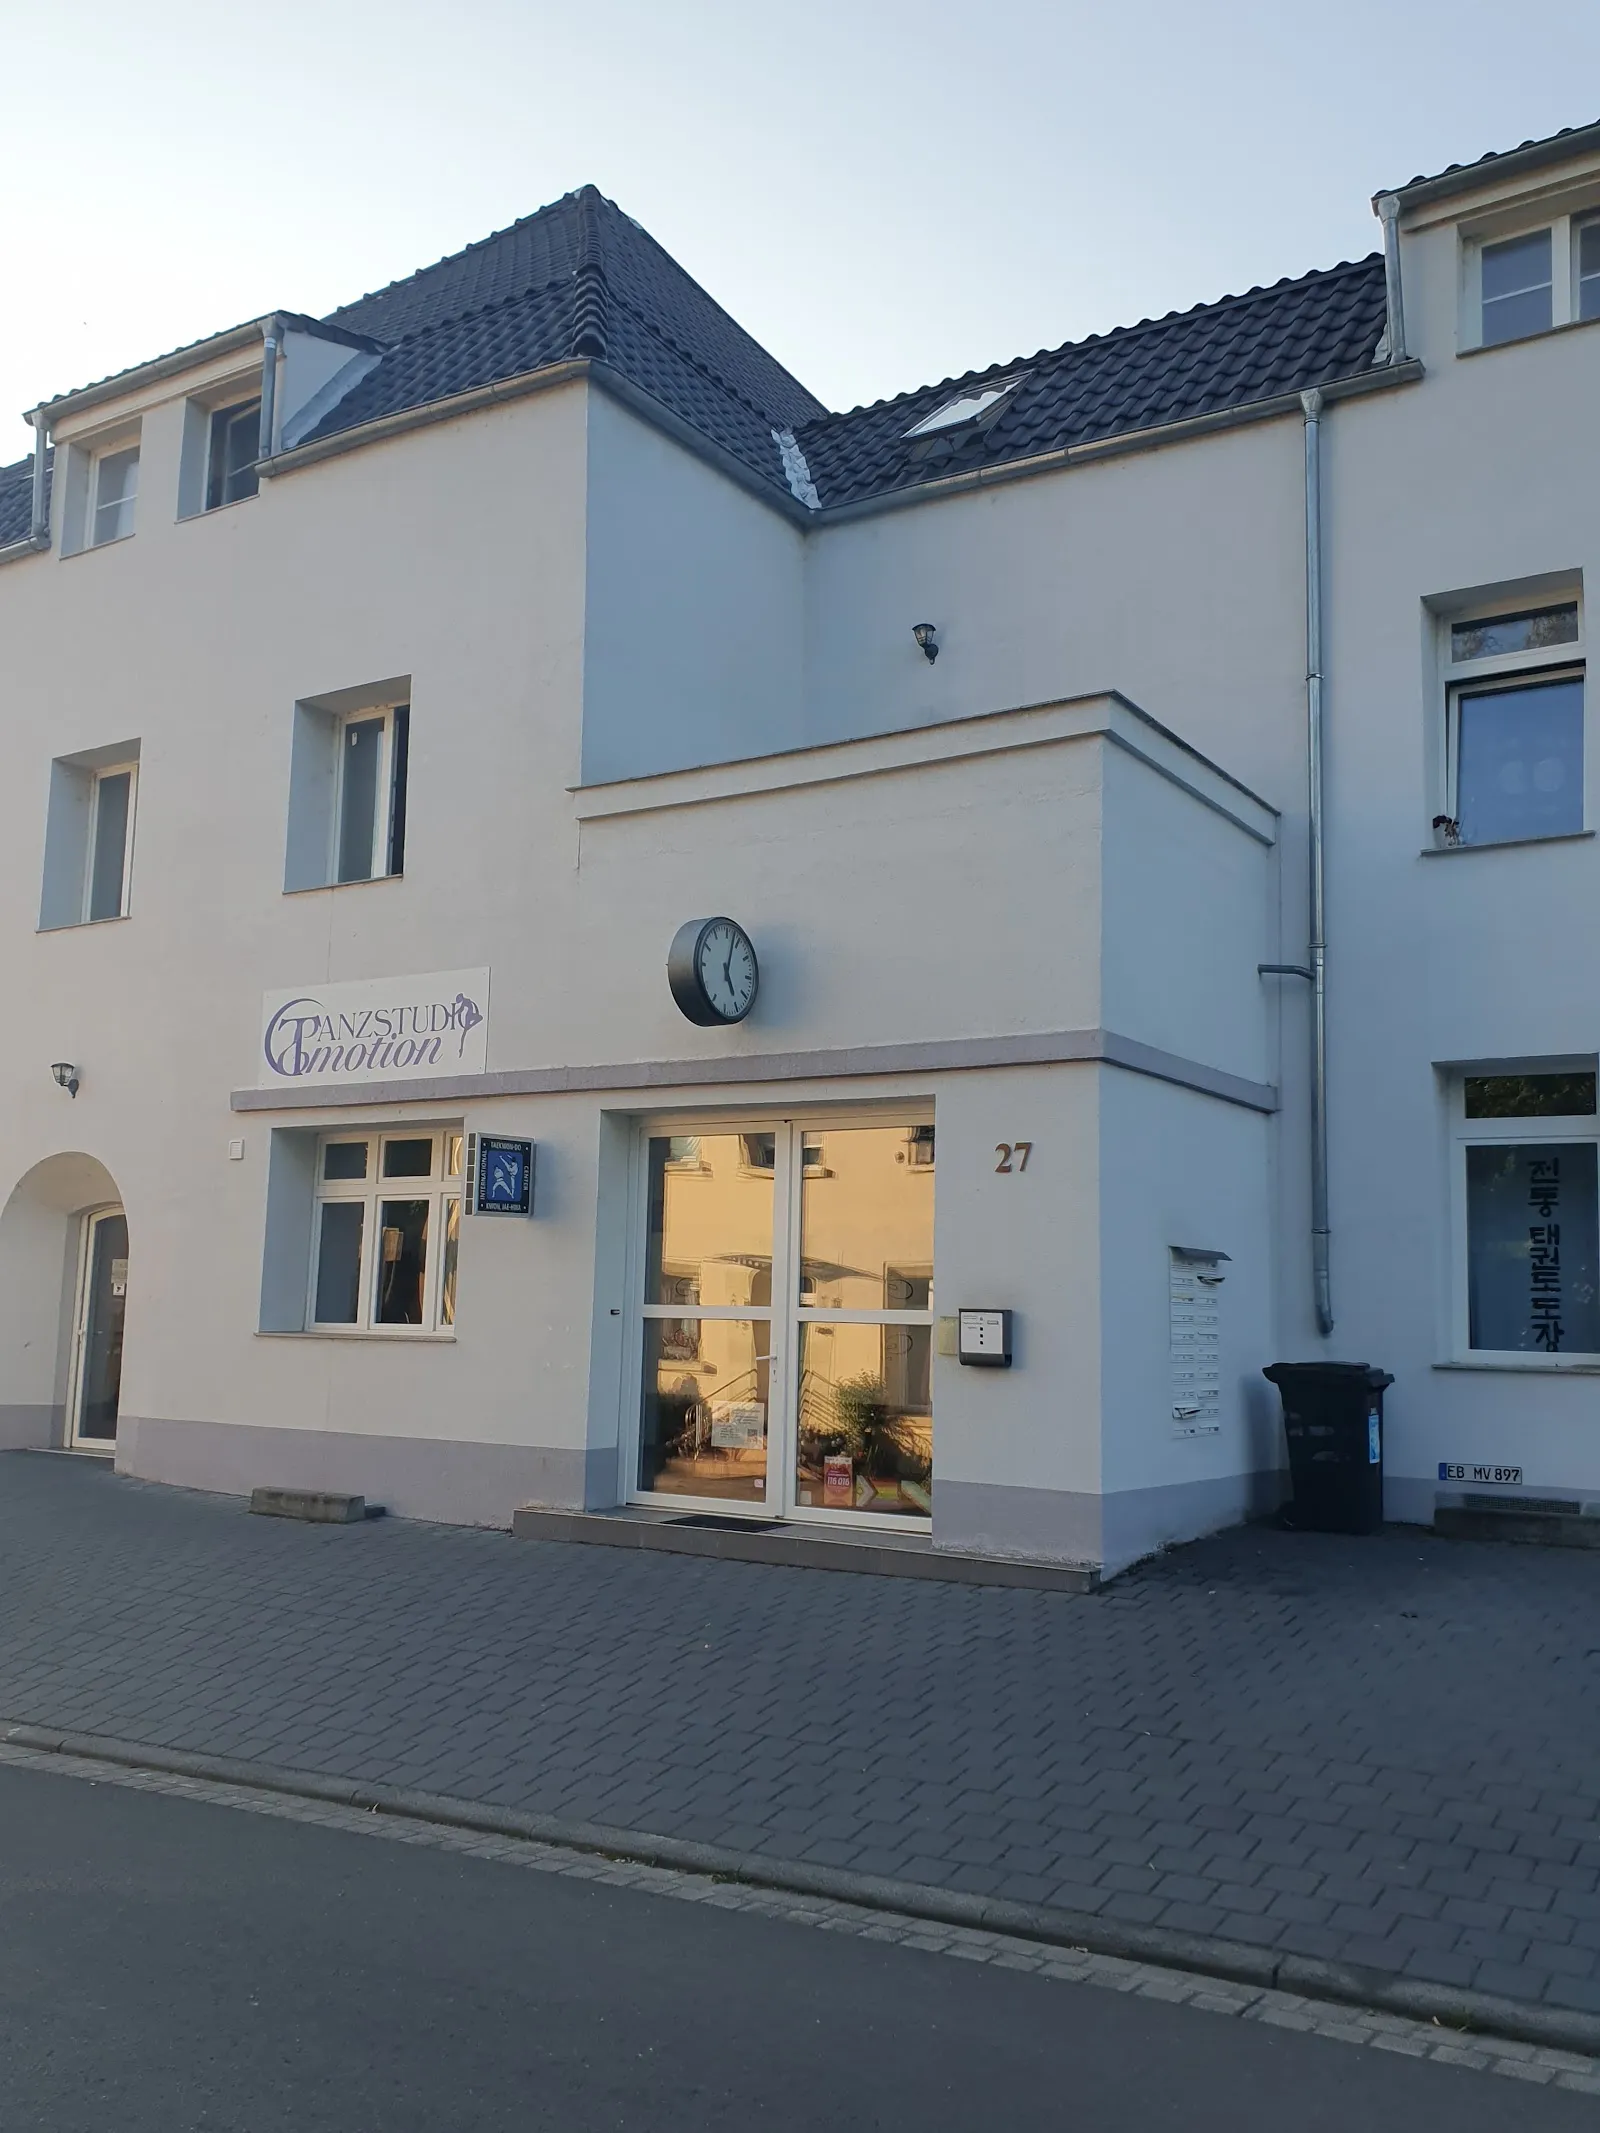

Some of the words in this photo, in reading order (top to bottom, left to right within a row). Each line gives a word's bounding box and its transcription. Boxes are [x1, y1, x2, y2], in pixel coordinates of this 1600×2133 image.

[995, 1142, 1032, 1173] 27
[1447, 1465, 1465, 1479] EB
[1473, 1467, 1492, 1480] MV
[1494, 1468, 1520, 1482] 897
